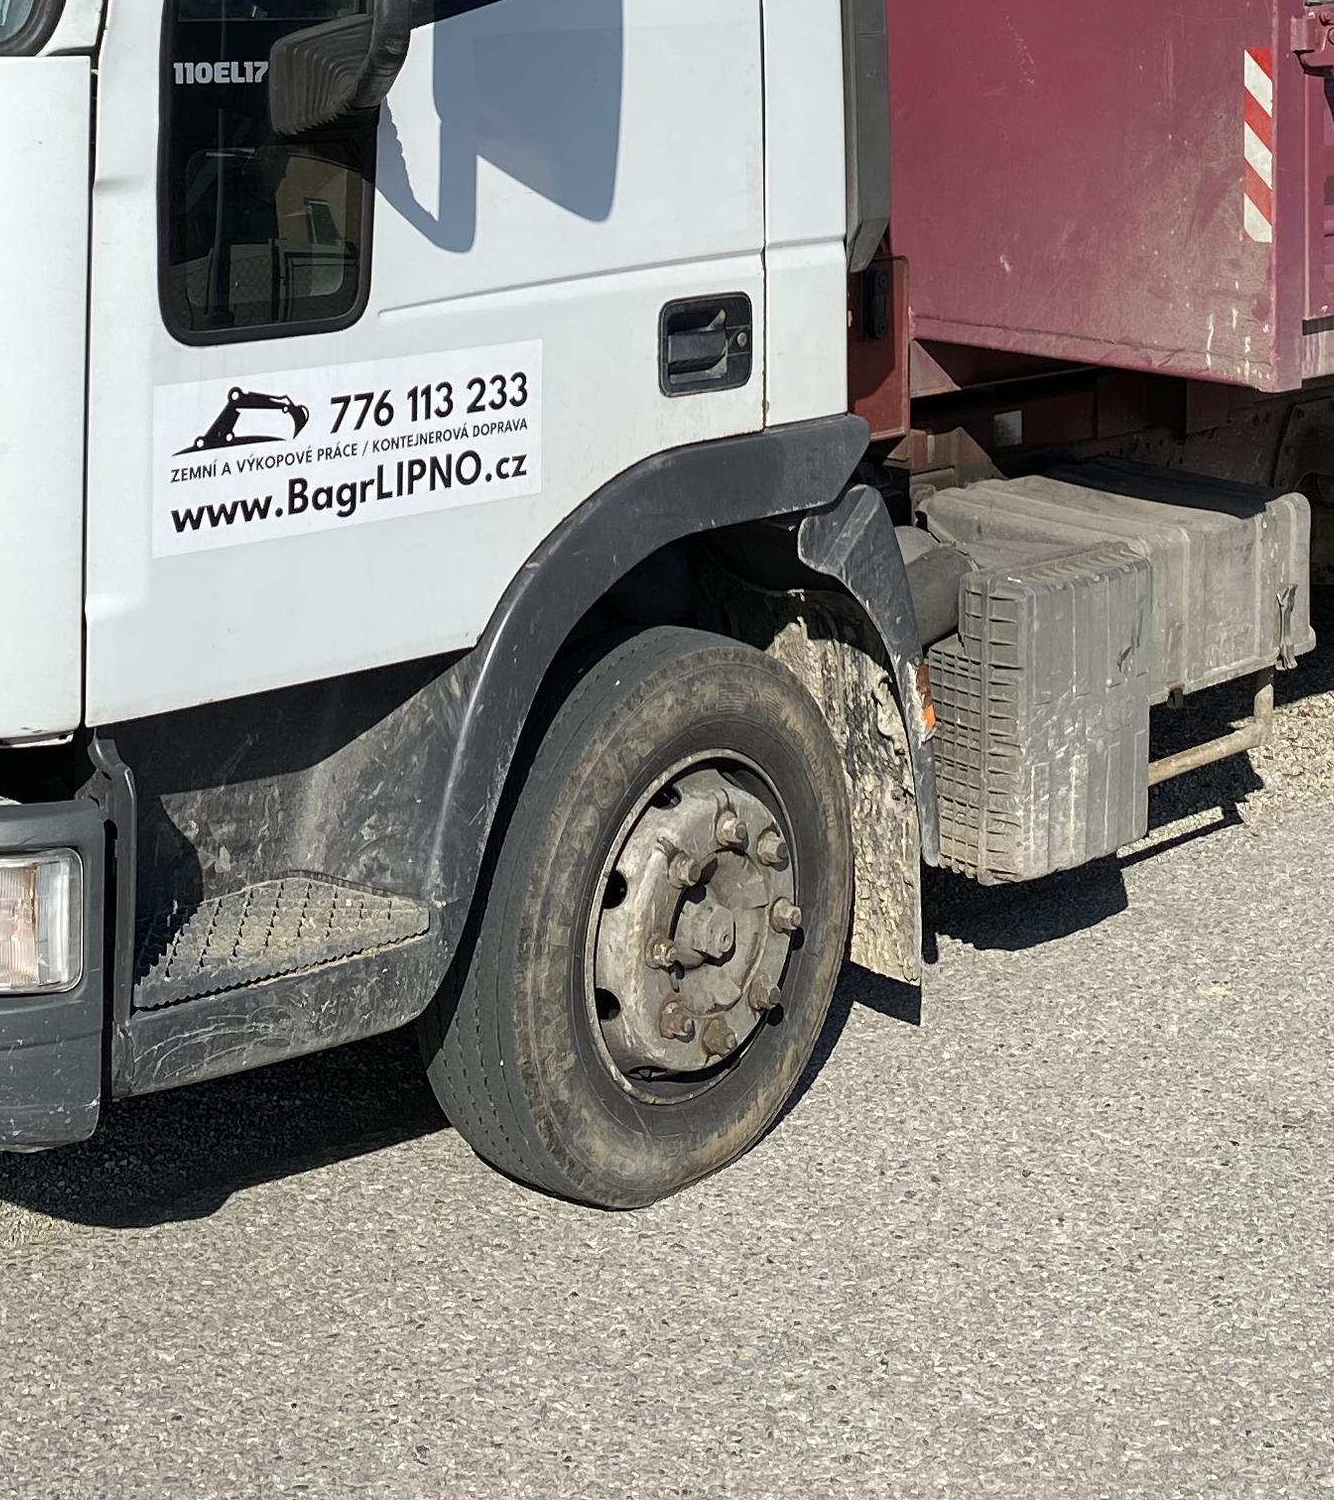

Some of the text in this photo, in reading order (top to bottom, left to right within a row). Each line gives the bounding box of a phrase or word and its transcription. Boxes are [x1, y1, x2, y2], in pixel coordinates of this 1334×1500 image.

[173, 61, 269, 85] 110EL17
[330, 371, 529, 435] 776 113 233
[170, 416, 529, 484] ZEMNÍ A VÝKOPOVÉ PRÁCE / KONTEJNEROVÁ DOPRAVA
[170, 449, 529, 534] www.BagrLIPNO.cz
